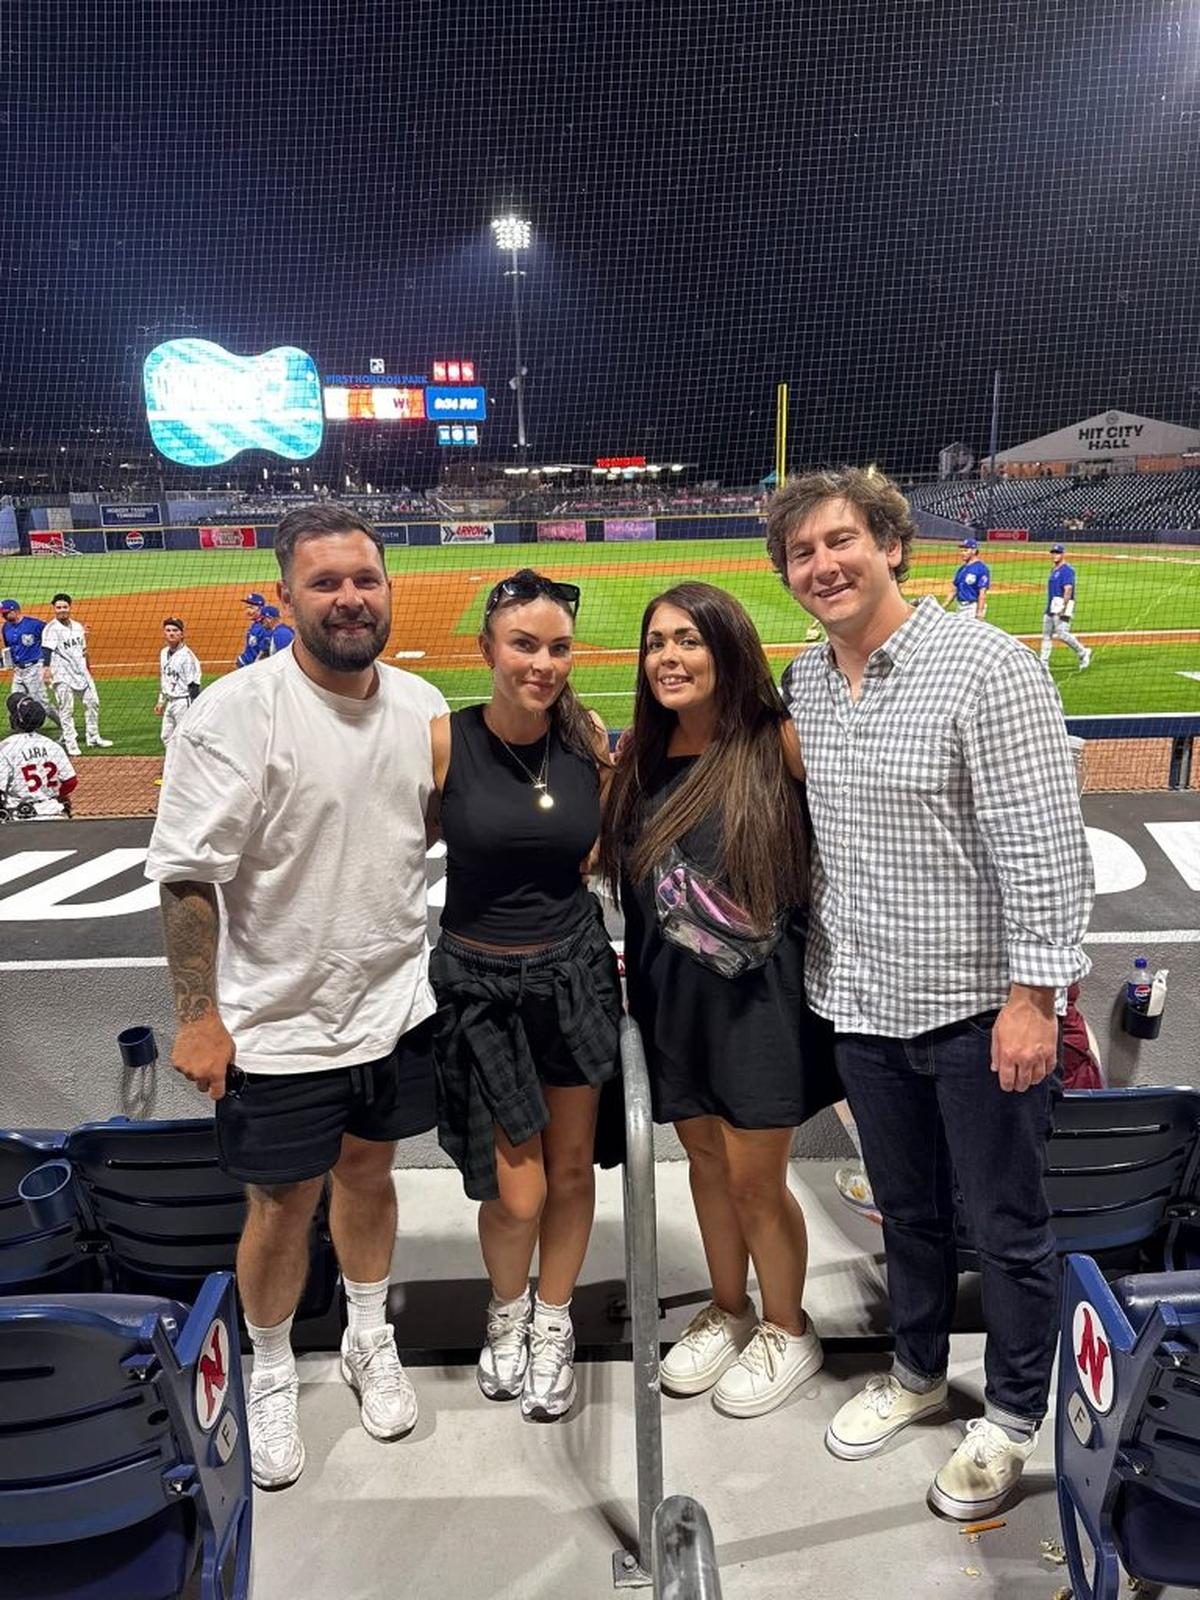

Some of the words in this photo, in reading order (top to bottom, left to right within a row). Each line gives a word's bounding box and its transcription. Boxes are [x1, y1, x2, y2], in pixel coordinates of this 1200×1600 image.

[1078, 427, 1104, 440] HIT
[1106, 424, 1144, 439] CITY
[1088, 439, 1130, 451] HALL
[21, 747, 49, 762] LARA
[21, 761, 58, 793] 52
[1074, 1406, 1086, 1424] F
[220, 1423, 231, 1448] F
